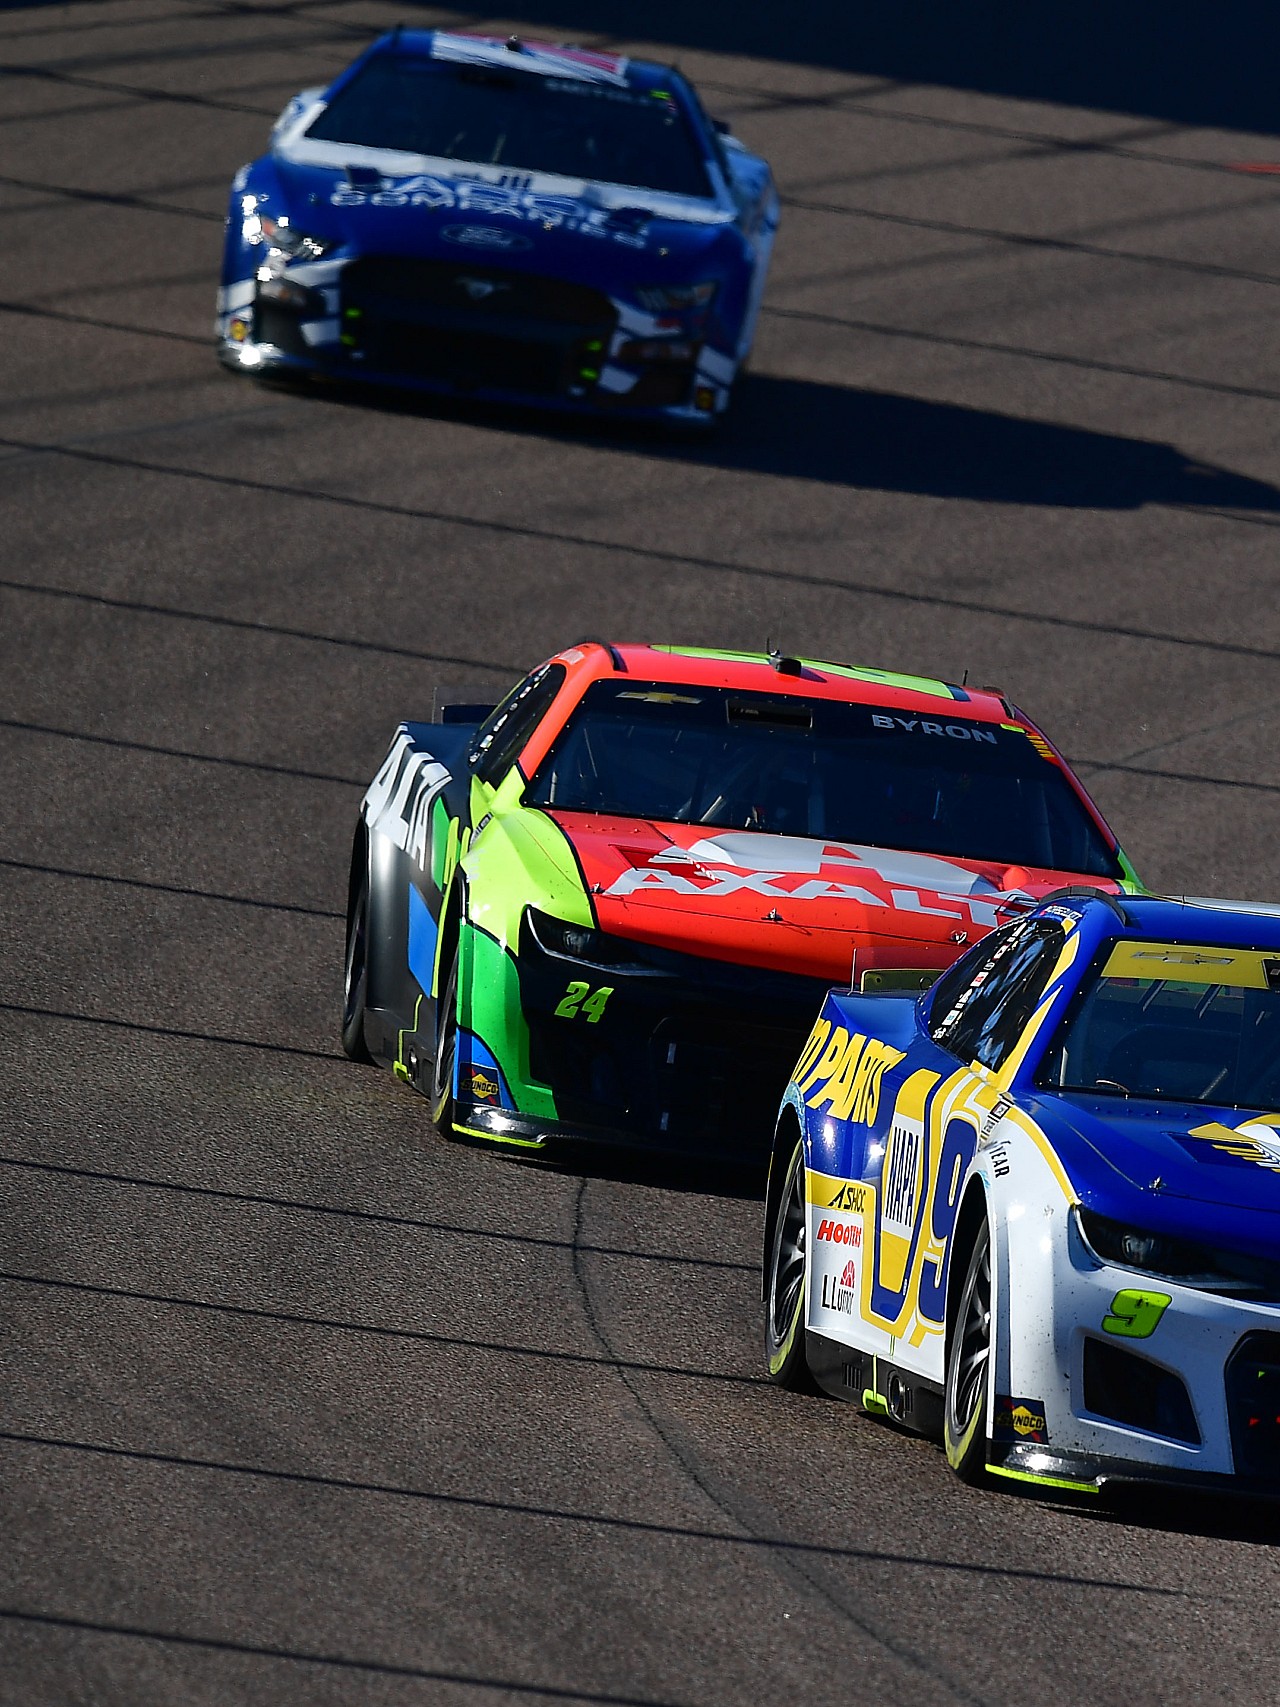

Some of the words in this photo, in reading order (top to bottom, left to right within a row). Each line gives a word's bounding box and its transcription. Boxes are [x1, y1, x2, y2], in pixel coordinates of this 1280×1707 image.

[871, 714, 998, 745] BYRON
[360, 721, 453, 872] ALTA
[605, 867, 1004, 929] AXALT
[554, 981, 615, 1023] 24
[799, 1025, 908, 1128] PARTS
[885, 1124, 920, 1228] NAPA
[1101, 1288, 1172, 1339] 9
